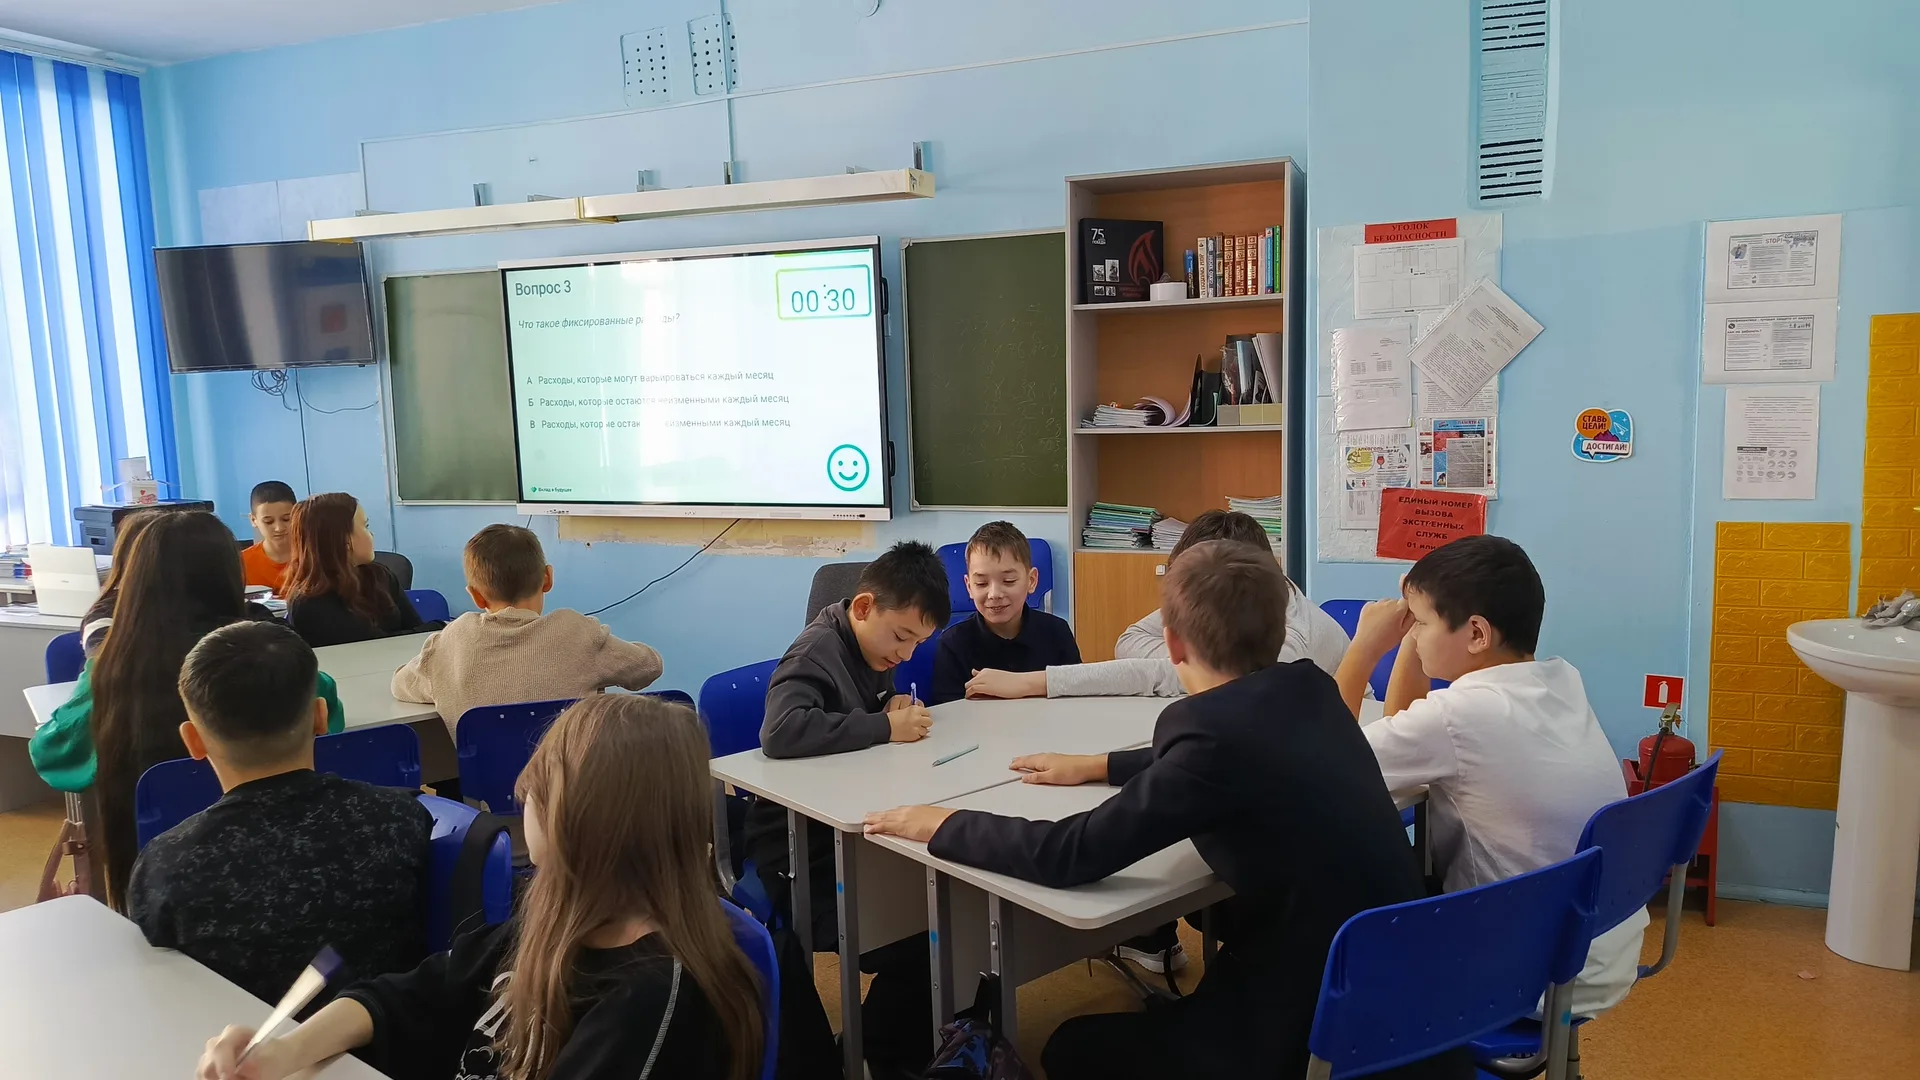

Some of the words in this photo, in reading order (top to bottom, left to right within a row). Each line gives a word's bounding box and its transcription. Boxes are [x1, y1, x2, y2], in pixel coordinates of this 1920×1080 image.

[1392, 222, 1429, 232] УГОЛОК
[1091, 228, 1104, 240] 75
[1373, 231, 1447, 242] БЕЗОПАСНОСТИ
[515, 281, 561, 297] Вопрос
[564, 280, 572, 293] 3
[791, 284, 855, 313] 00:30
[518, 319, 533, 329] Что
[536, 319, 560, 329] такое
[561, 316, 634, 329] фиксированные
[526, 376, 533, 385] А
[538, 375, 576, 386] Расходы,
[577, 375, 612, 385] которые
[614, 374, 638, 384] могут
[640, 373, 705, 383] варьироваться
[707, 371, 743, 381] каждый
[745, 371, 774, 381] месяц
[528, 398, 534, 407] Б
[540, 397, 577, 408] Расходы,
[722, 394, 758, 404] каждый
[760, 394, 789, 404] месяц
[530, 420, 536, 429] В
[541, 420, 579, 430] Расходы,
[724, 417, 760, 428] каждый
[761, 418, 790, 428] месяц
[1582, 415, 1607, 423] СТАВЬ
[1582, 422, 1606, 430] ЦЕЛИ!
[1586, 442, 1627, 451] ДОСТИГАЙ!
[1398, 496, 1438, 506] ЕДИНЫЙ
[1440, 500, 1473, 509] НОМЕР
[1415, 508, 1453, 518] ВЫЗОВА
[1415, 530, 1448, 540] СЛУЖБ
[1406, 541, 1417, 549] 01
